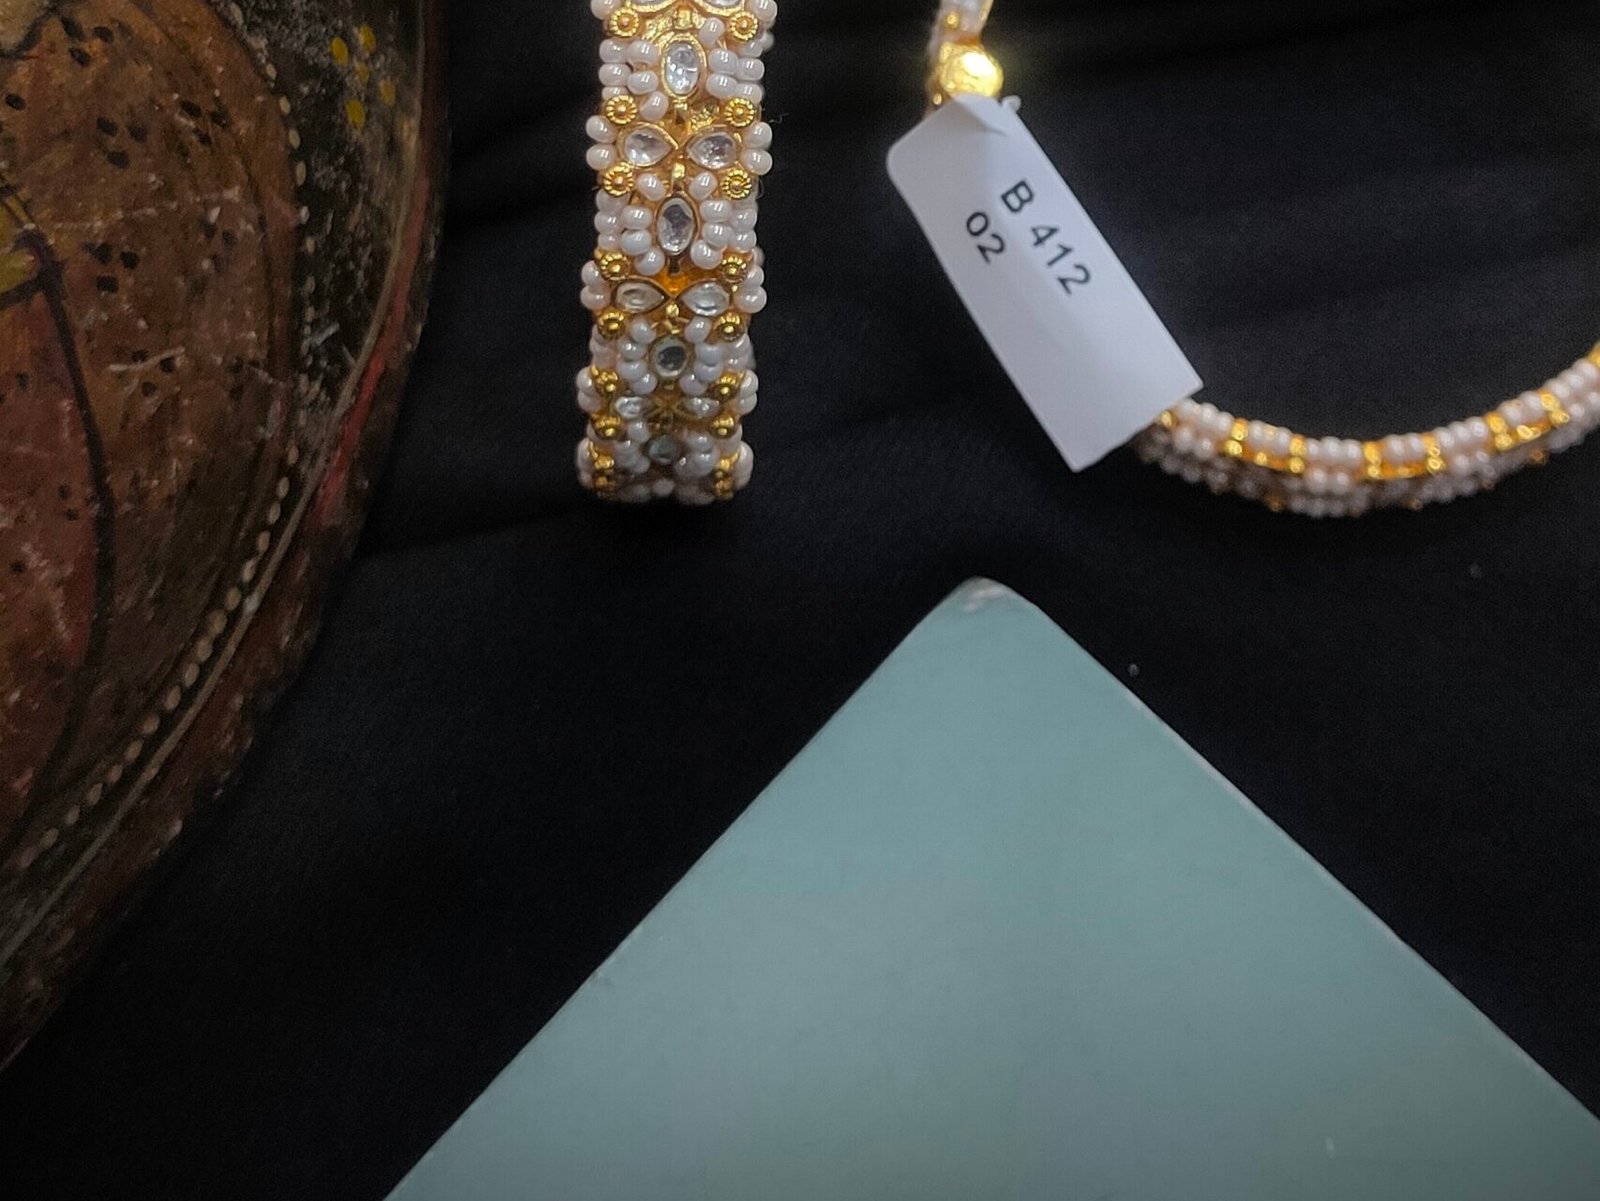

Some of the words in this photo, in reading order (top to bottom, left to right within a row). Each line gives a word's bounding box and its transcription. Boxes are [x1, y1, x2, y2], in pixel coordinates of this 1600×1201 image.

[965, 210, 1006, 265] 02
[1000, 180, 1035, 214] B
[1031, 226, 1091, 295] 412
